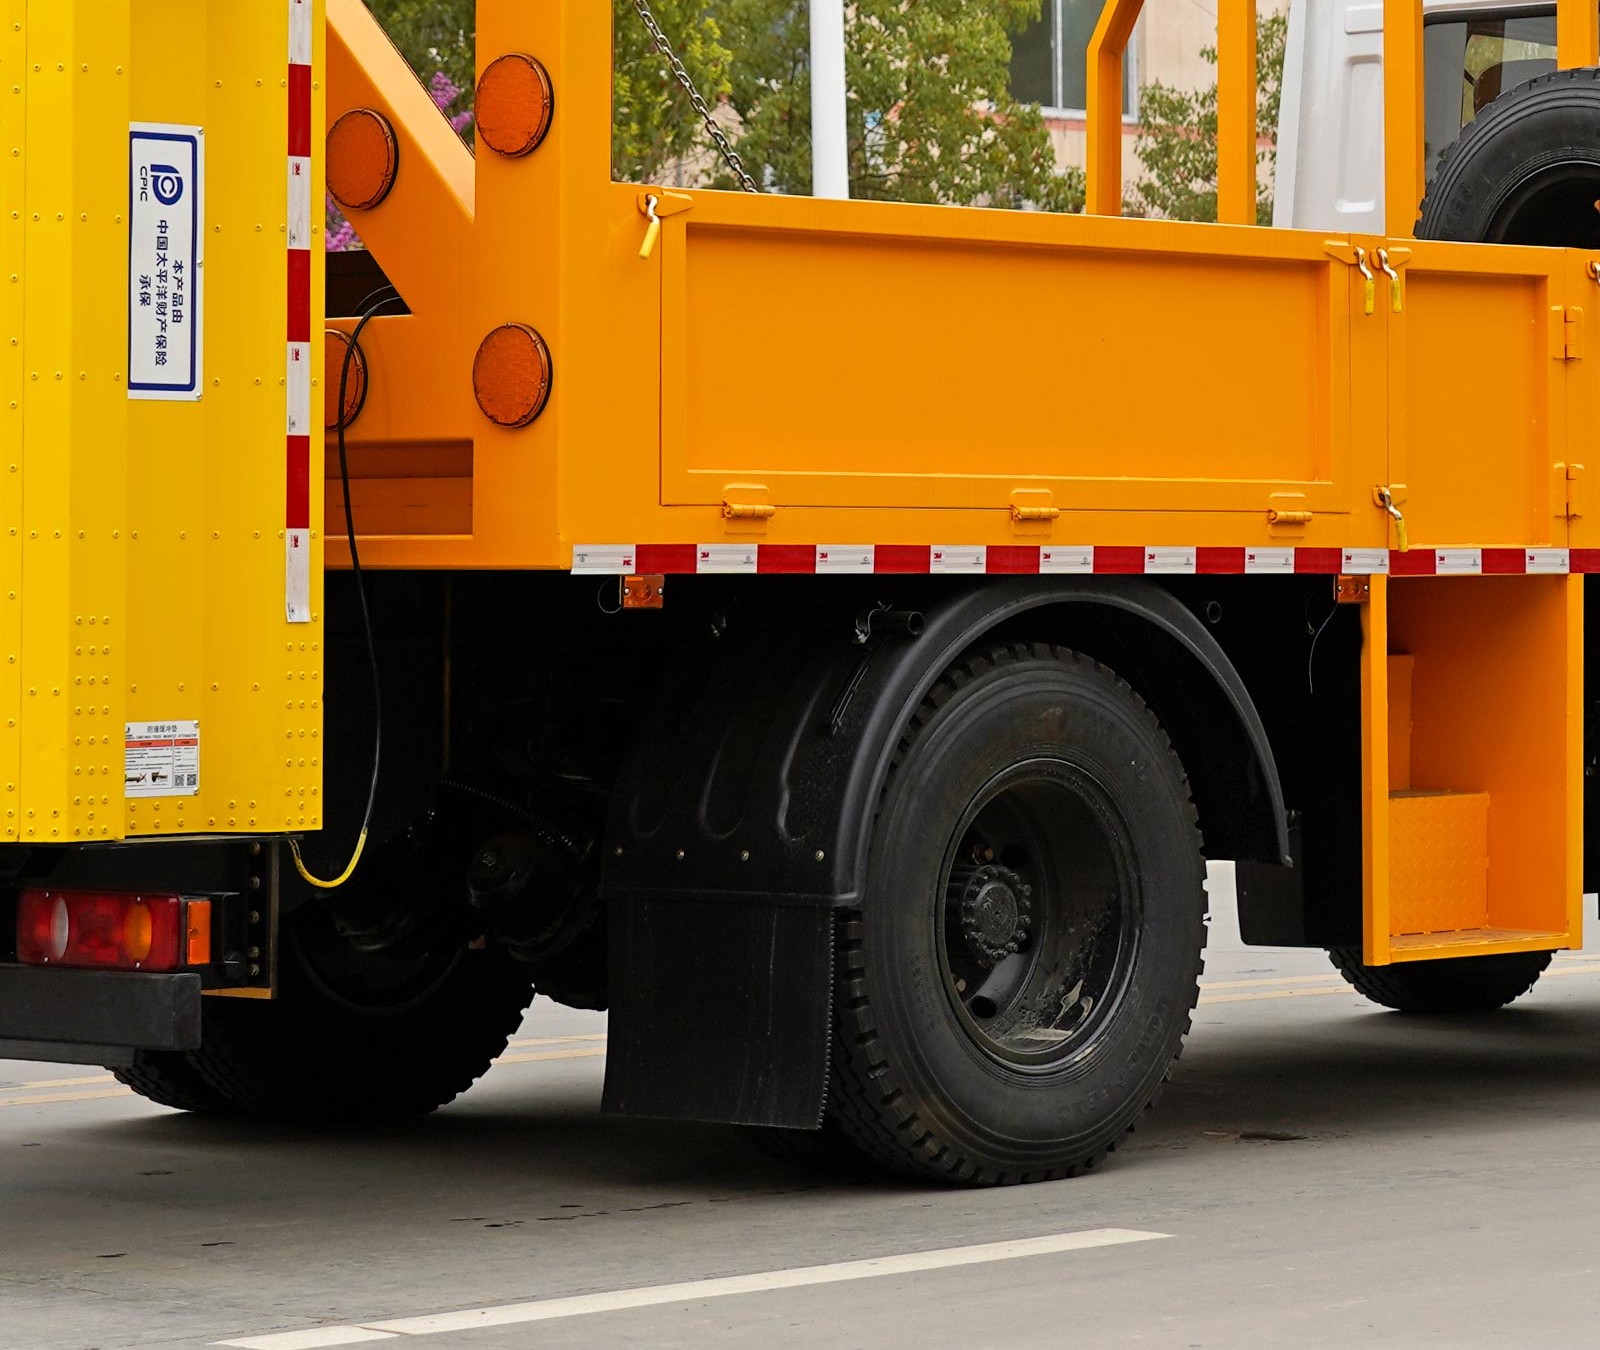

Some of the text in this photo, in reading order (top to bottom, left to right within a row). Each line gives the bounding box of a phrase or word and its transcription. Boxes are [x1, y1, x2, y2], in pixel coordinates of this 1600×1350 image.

[140, 165, 148, 202] CPIC
[139, 274, 152, 307] 承保
[155, 219, 169, 367] 中国太平洋财产保险
[171, 259, 185, 324] 本产品由
